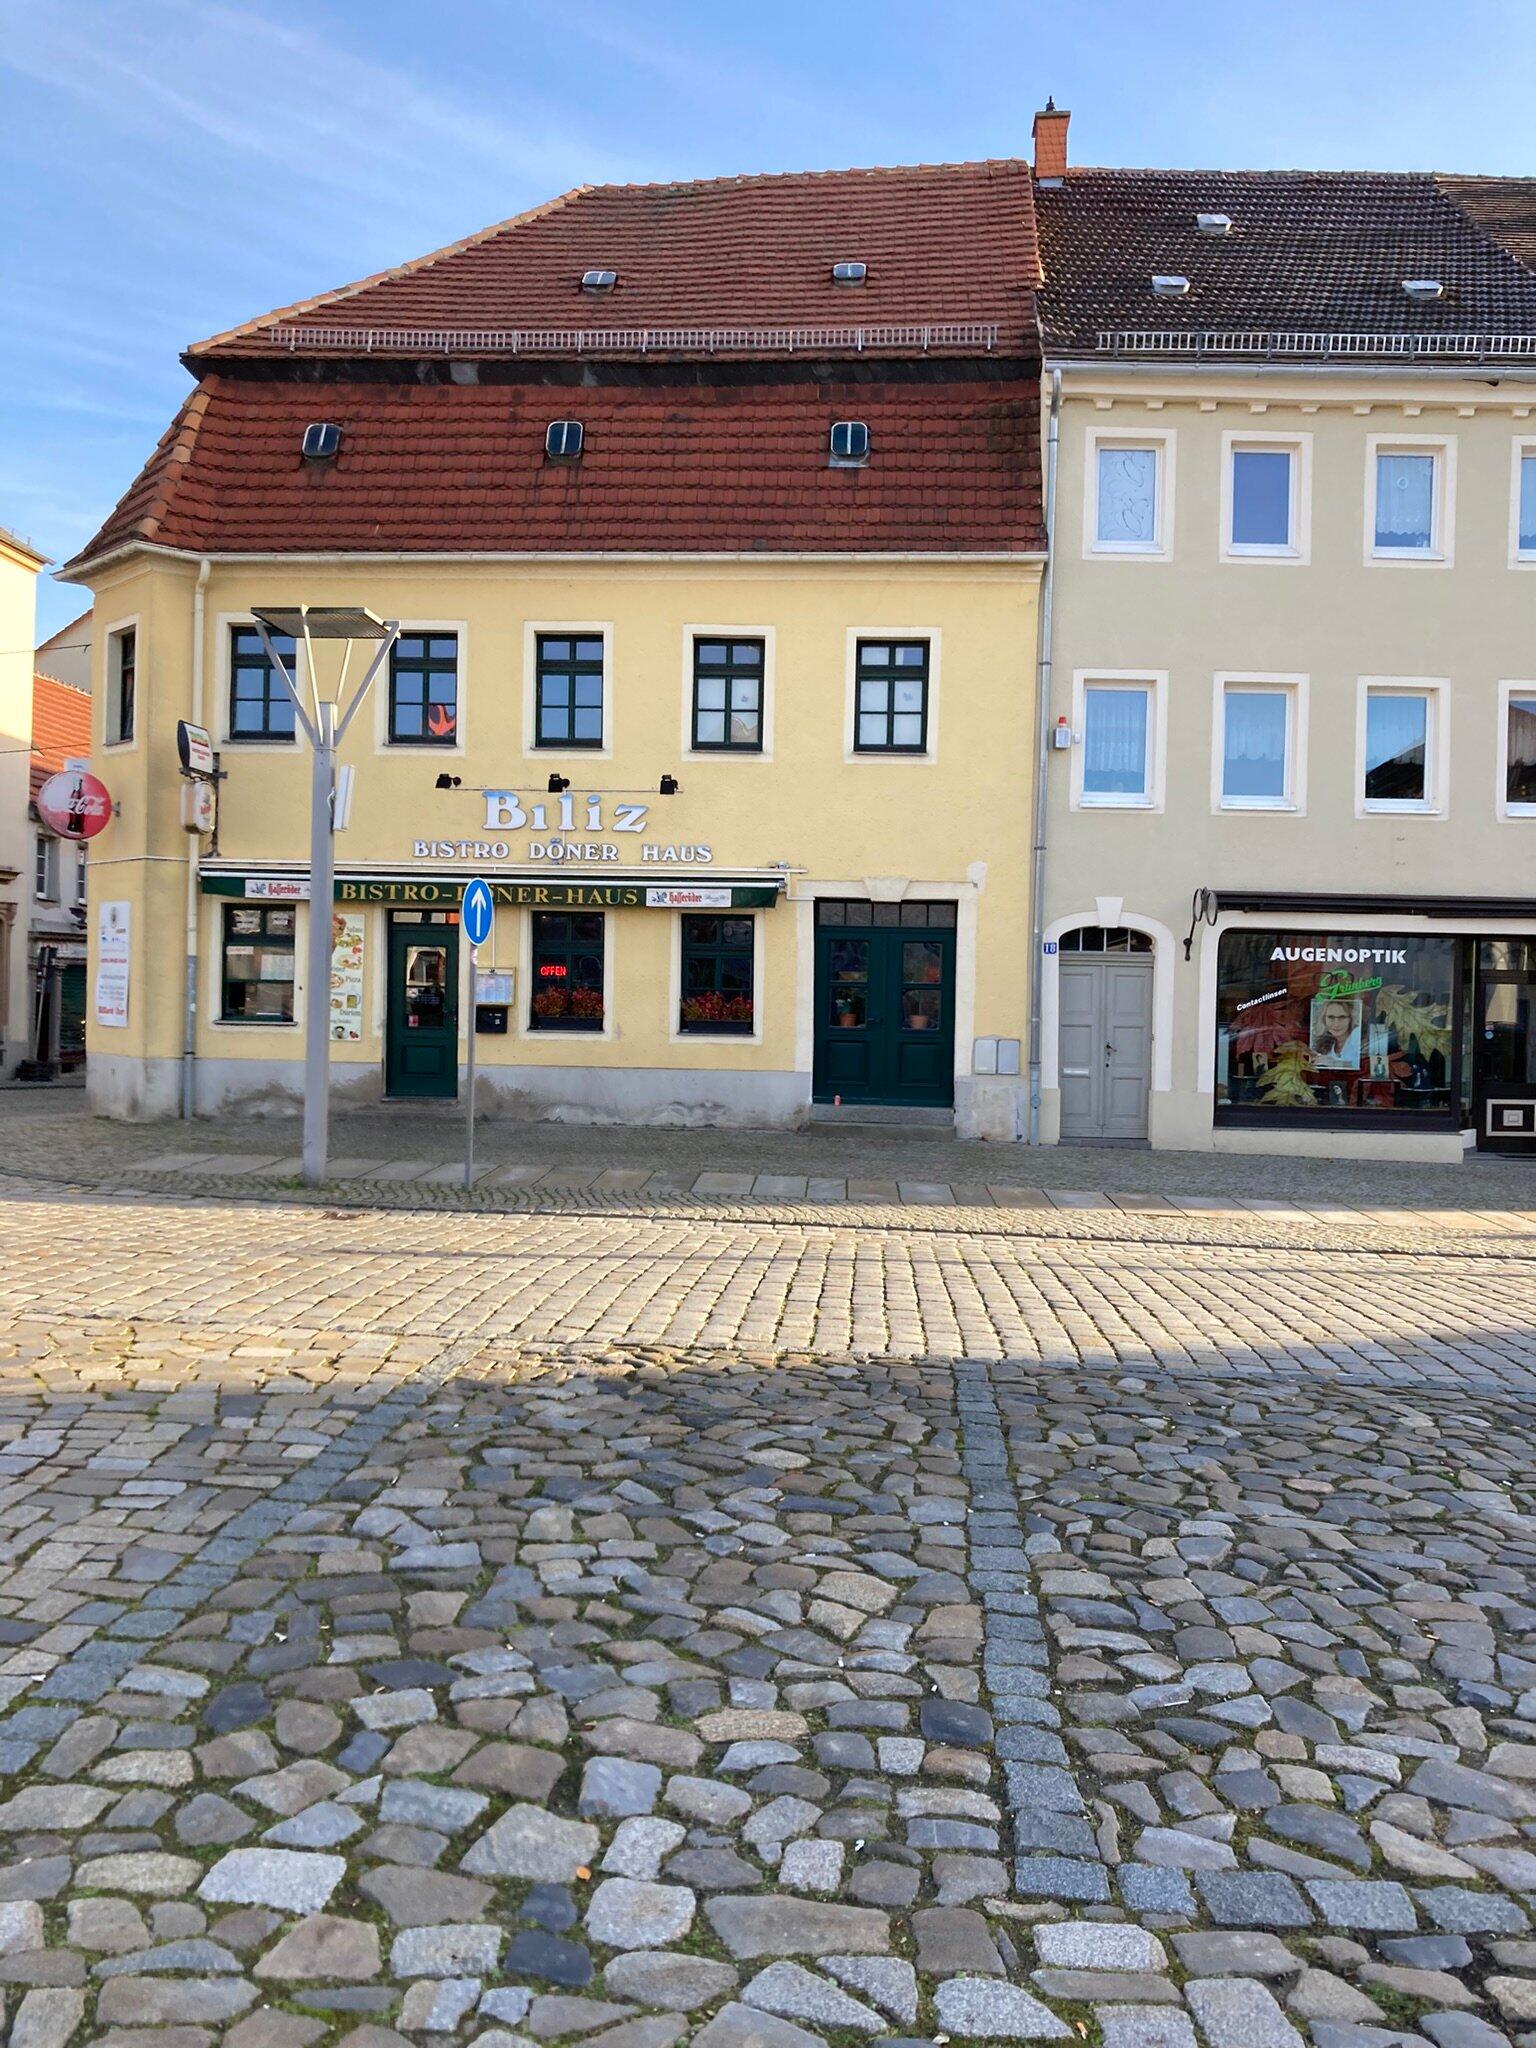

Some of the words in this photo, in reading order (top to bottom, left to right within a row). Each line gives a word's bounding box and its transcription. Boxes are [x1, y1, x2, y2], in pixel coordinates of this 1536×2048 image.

[412, 840, 509, 860] BISTRO
[528, 837, 619, 864] DÖNER
[642, 844, 713, 863] HAUS
[341, 883, 638, 906] BISTRO-NER-HAUS
[1045, 943, 1056, 953] 18
[1270, 946, 1407, 964] AUGENOPTIK
[540, 966, 567, 977] OFFEN
[1236, 987, 1288, 1012] Contactlinsen
